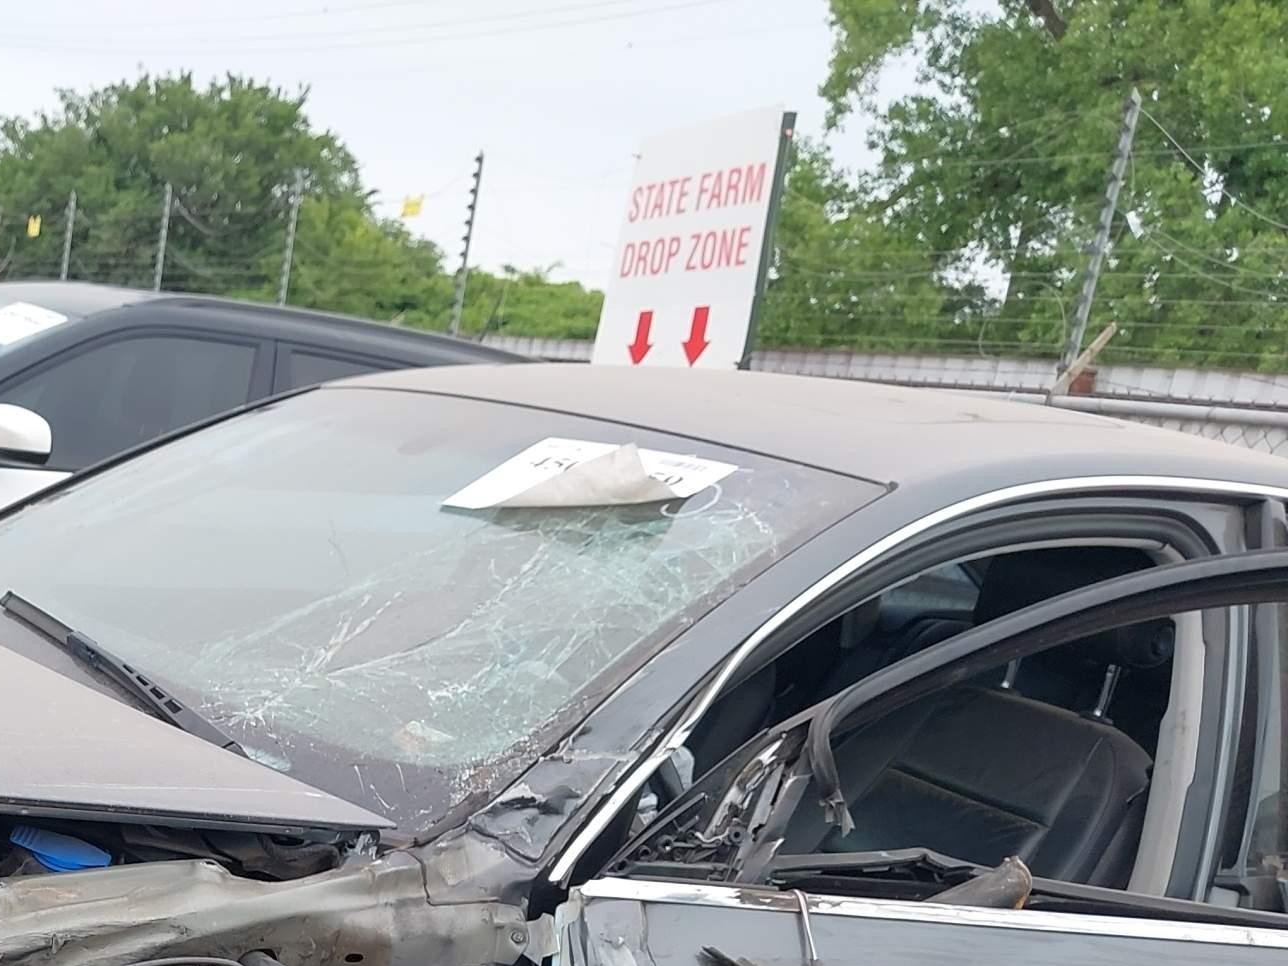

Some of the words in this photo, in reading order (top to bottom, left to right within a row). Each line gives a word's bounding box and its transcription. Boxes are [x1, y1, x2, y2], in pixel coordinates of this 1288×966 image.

[628, 177, 691, 222] STATE
[695, 163, 766, 211] FARM
[620, 236, 681, 278] DROP
[685, 226, 751, 271] ZONE
